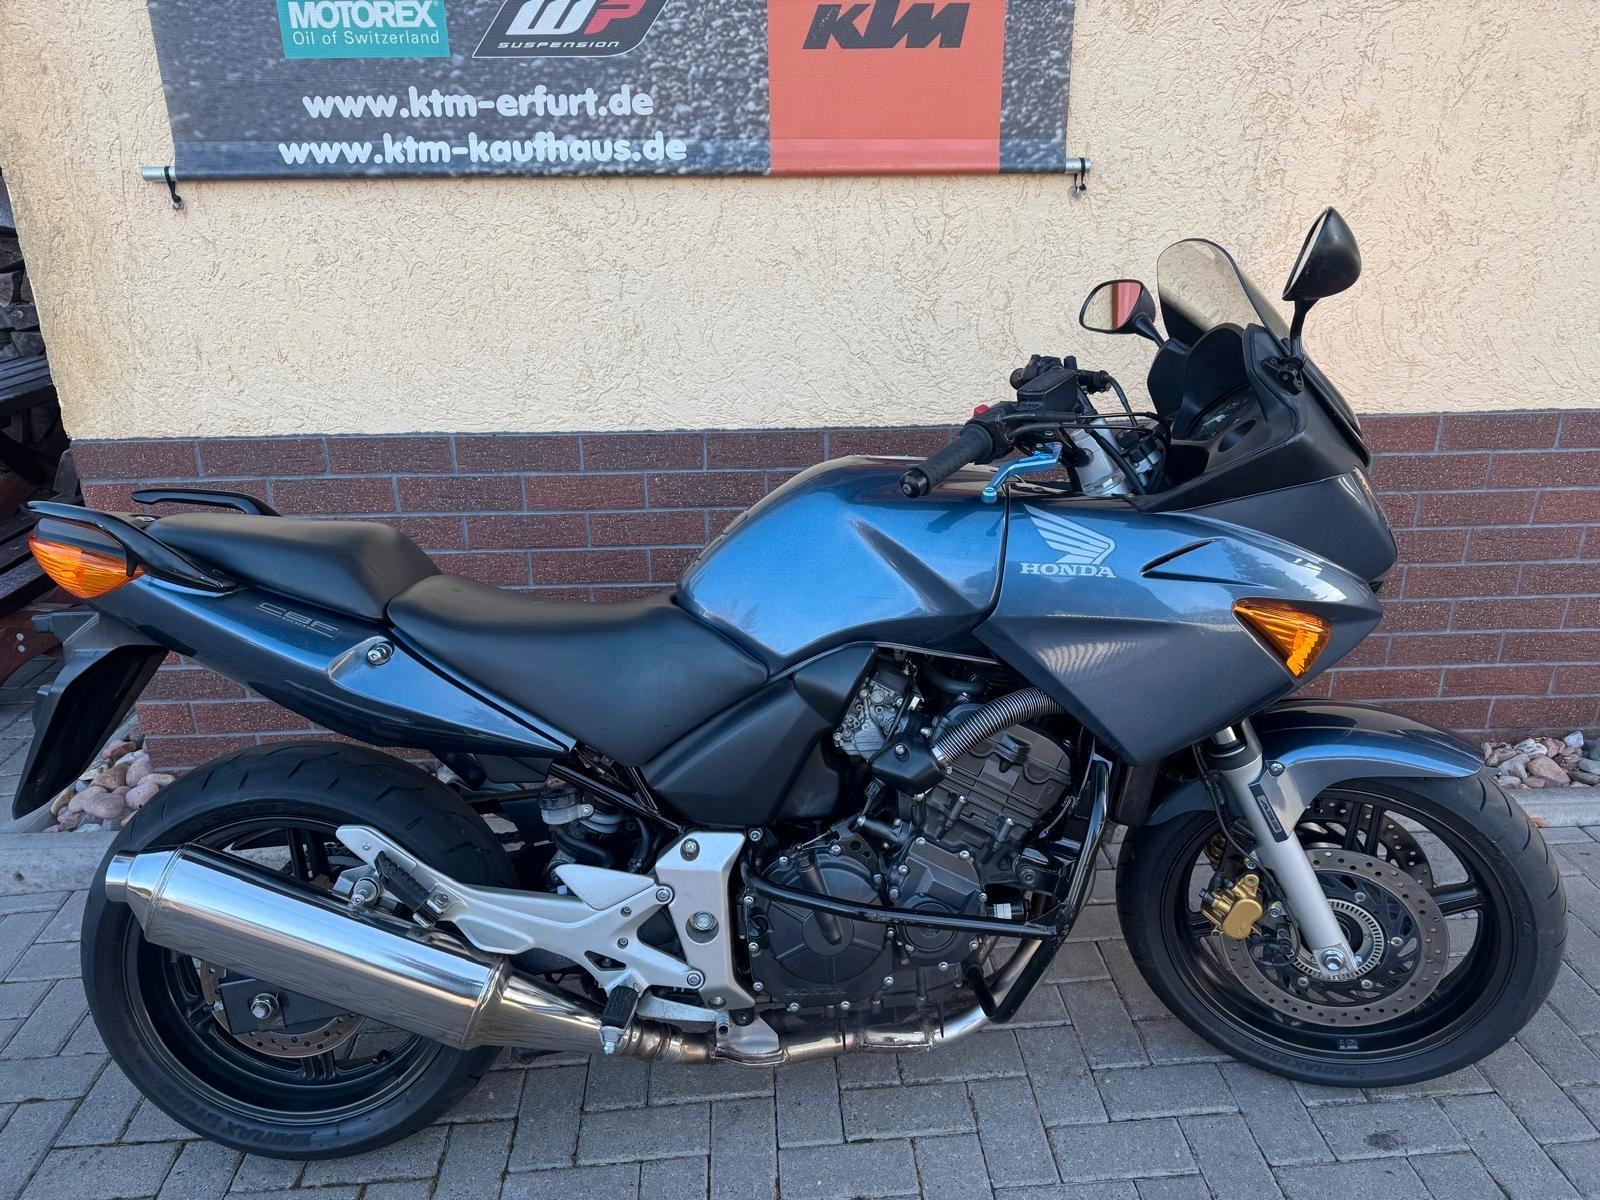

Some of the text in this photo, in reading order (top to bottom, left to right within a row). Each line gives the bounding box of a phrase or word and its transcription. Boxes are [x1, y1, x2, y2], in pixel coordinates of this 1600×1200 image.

[287, 0, 437, 29] MOTOREX
[802, 0, 971, 49] KTM
[293, 30, 440, 45] Oil of Switzerland
[497, 41, 620, 49] SUSPENSION
[302, 84, 654, 118] www.ktm-erfurt.de
[278, 131, 687, 165] www.ktm-kaufhaus.de
[1020, 562, 1116, 578] HONDA
[257, 602, 341, 633] CBF
